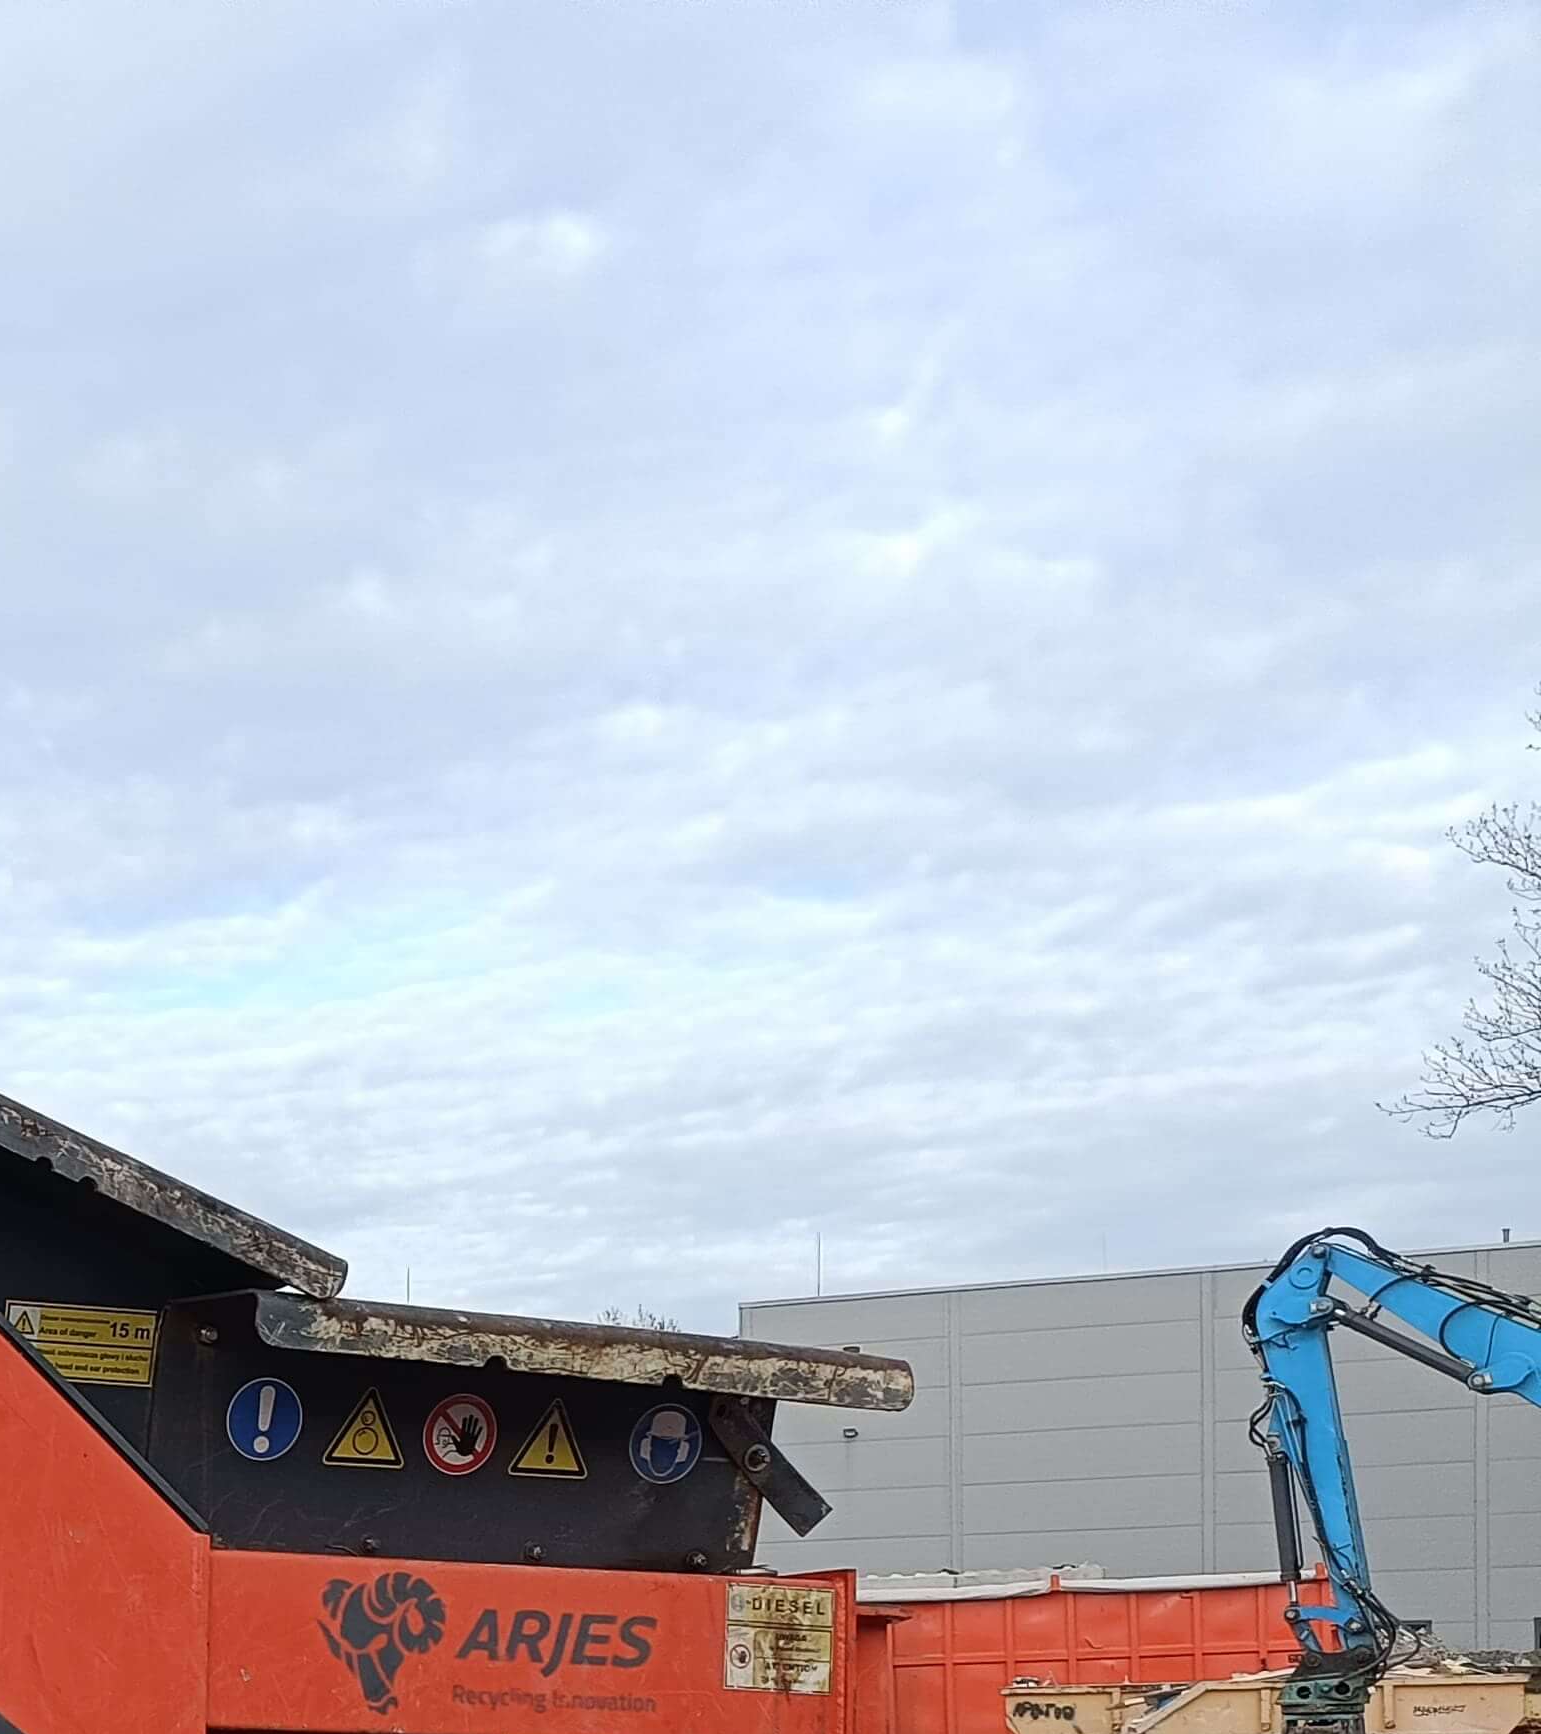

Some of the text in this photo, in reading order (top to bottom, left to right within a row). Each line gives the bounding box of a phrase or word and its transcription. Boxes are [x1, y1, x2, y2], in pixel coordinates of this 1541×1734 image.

[109, 1322, 150, 1340] 15 m
[454, 1608, 659, 1678] ARJES
[452, 1684, 548, 1714] Recycling
